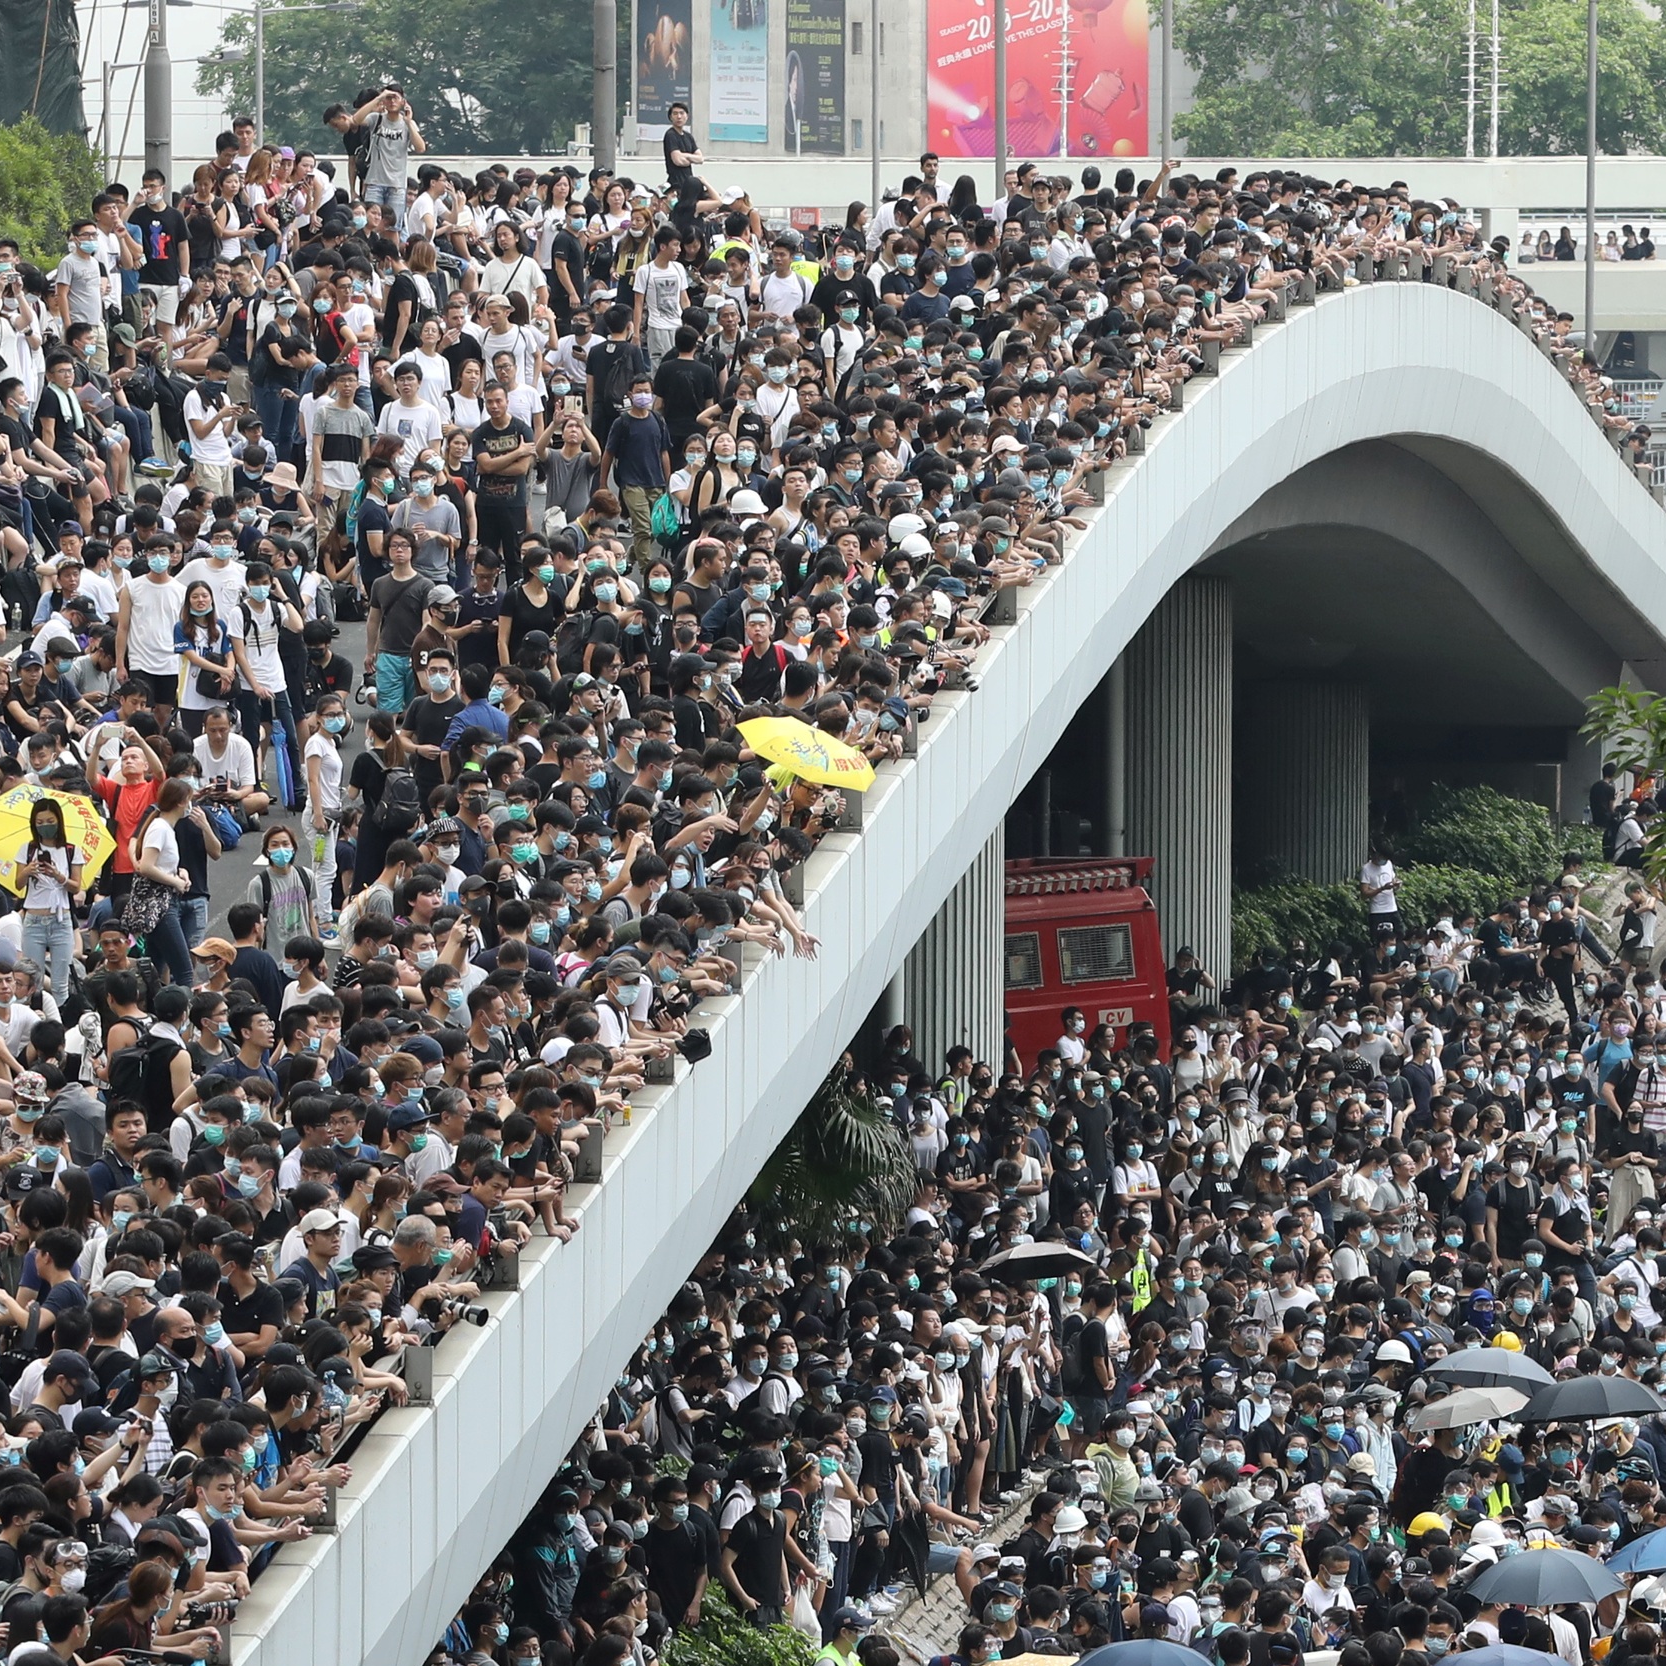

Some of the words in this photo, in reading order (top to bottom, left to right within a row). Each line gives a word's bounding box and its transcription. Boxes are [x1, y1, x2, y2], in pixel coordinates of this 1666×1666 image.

[939, 23, 966, 37] SEASON
[1035, 14, 1075, 34] CLASSIS
[1105, 1011, 1126, 1024] CV
